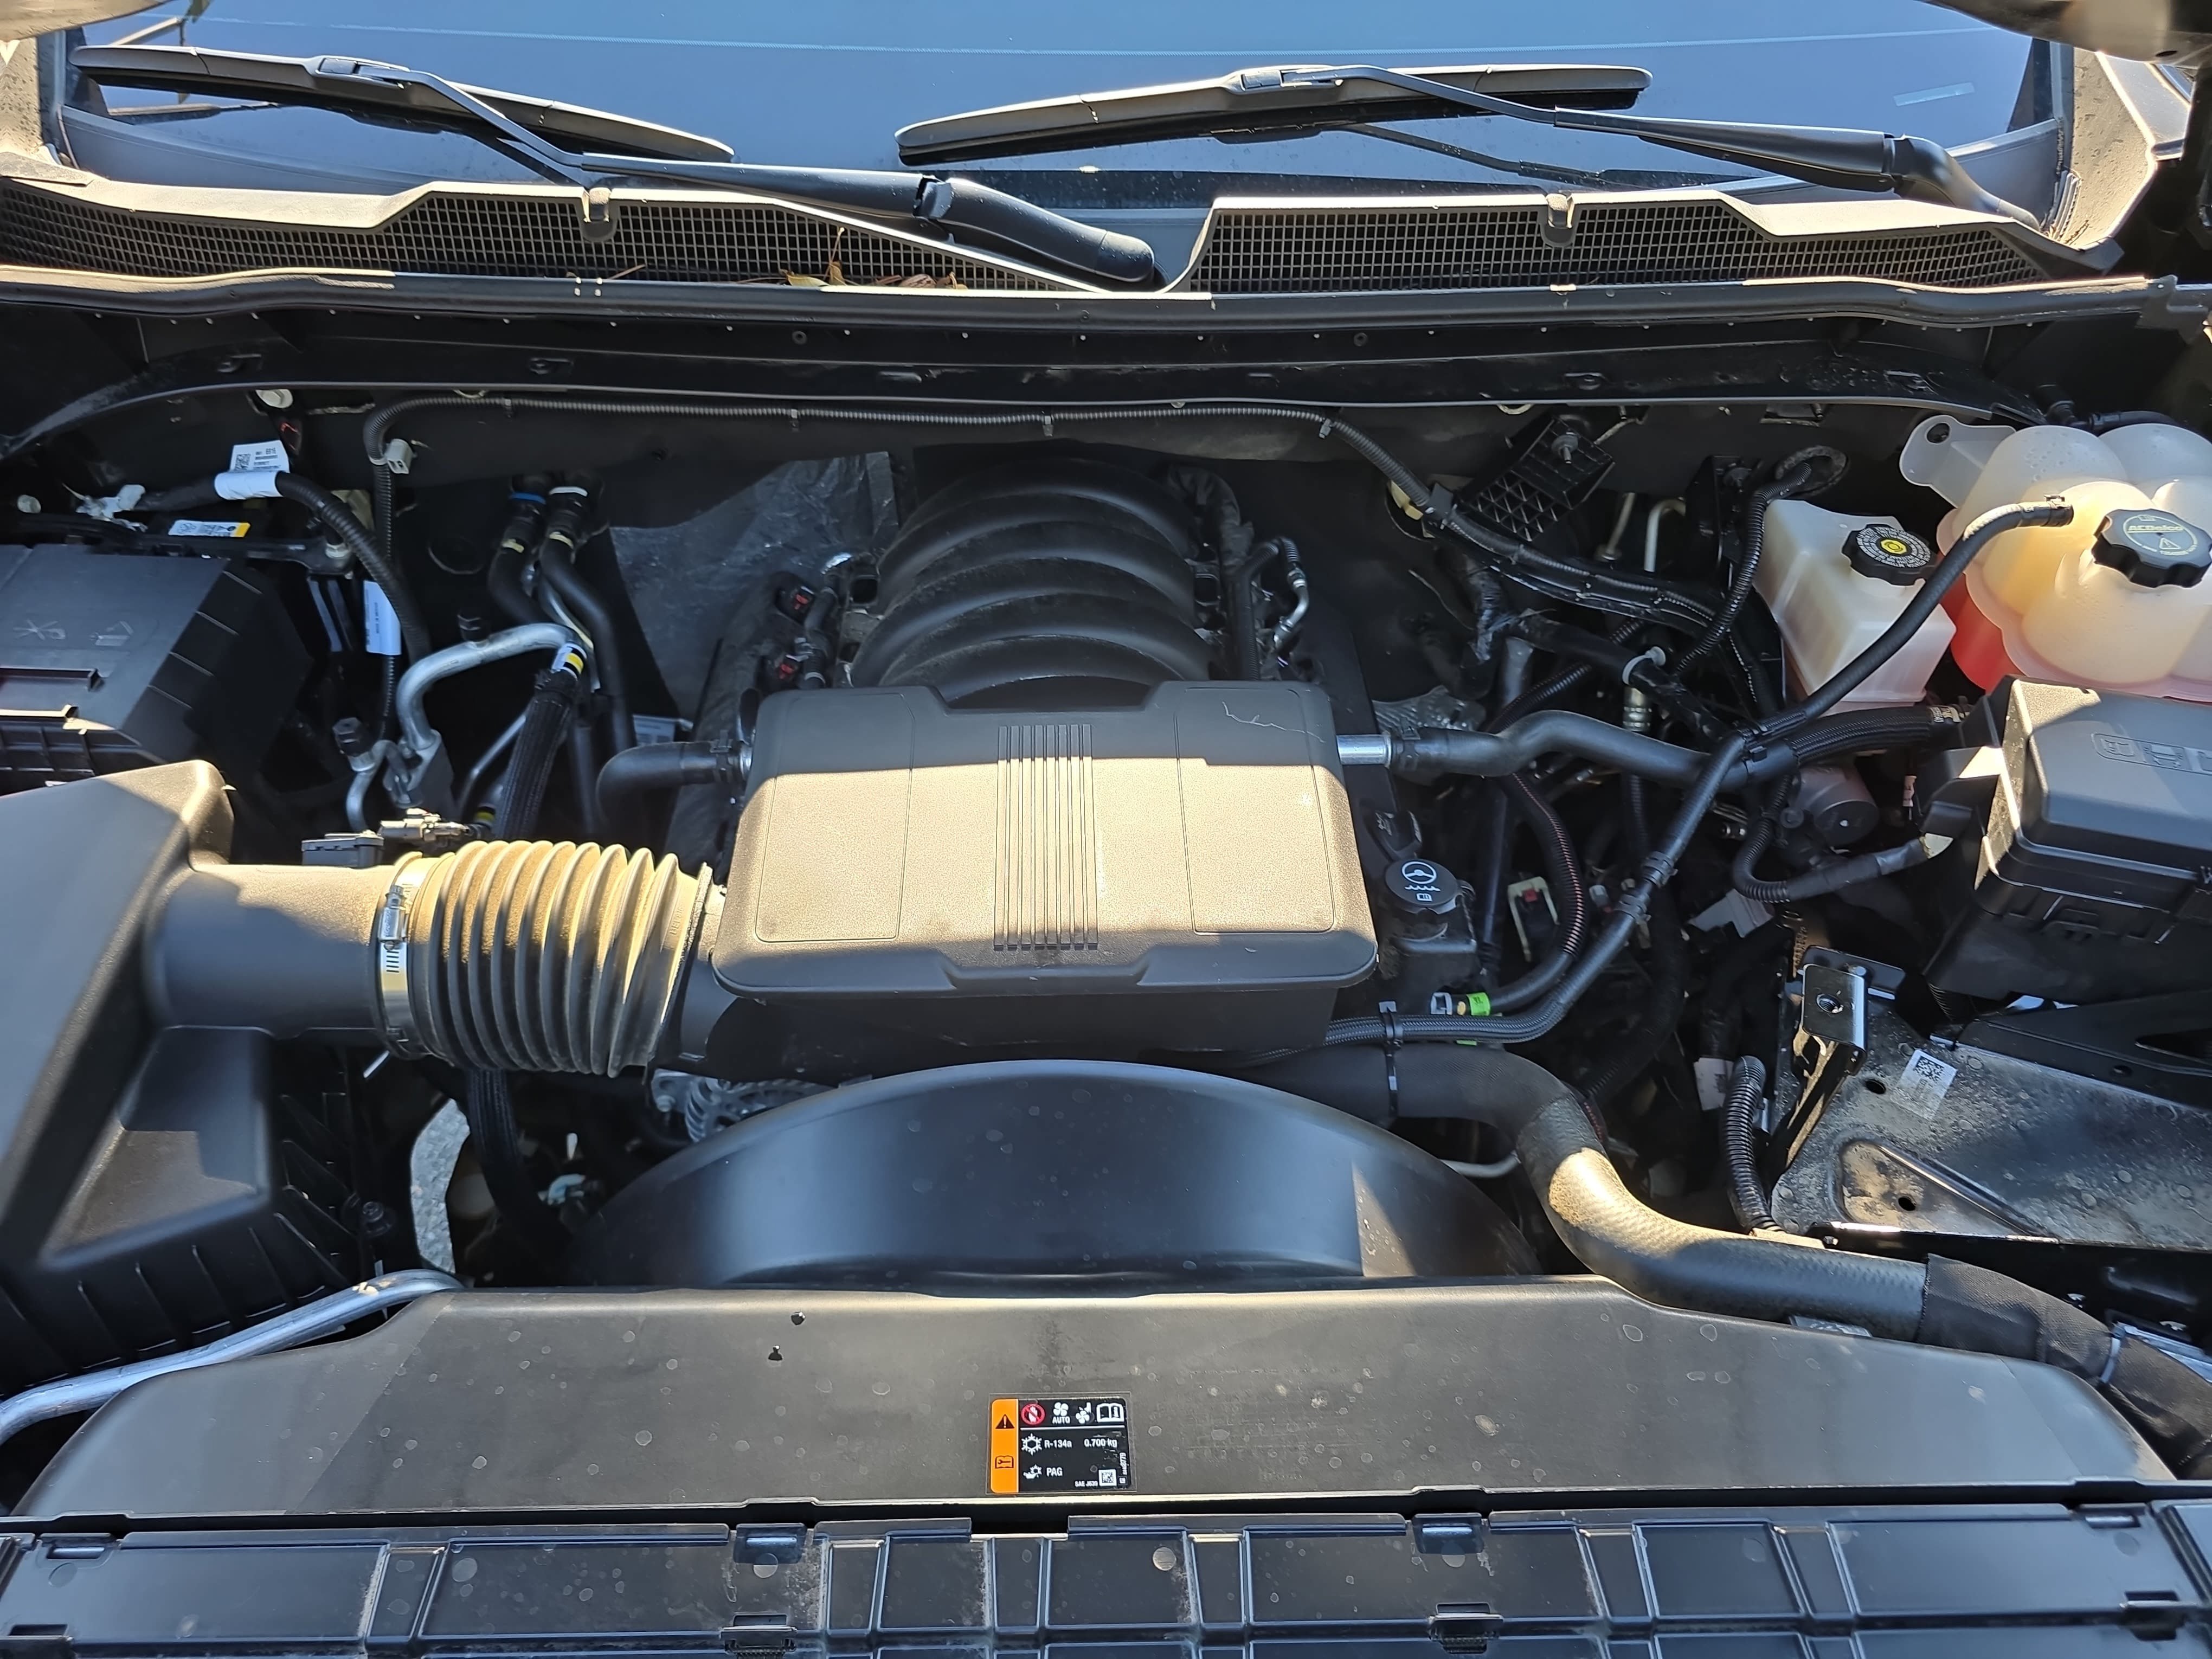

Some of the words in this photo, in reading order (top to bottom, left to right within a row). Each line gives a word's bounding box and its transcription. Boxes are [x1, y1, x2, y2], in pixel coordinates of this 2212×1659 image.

[1052, 1416, 1071, 1425] AUTO
[1044, 1439, 1072, 1449] R-134a
[1084, 1438, 1106, 1448] 0.700
[1107, 1437, 1117, 1449] kg
[1046, 1467, 1063, 1477] PAG
